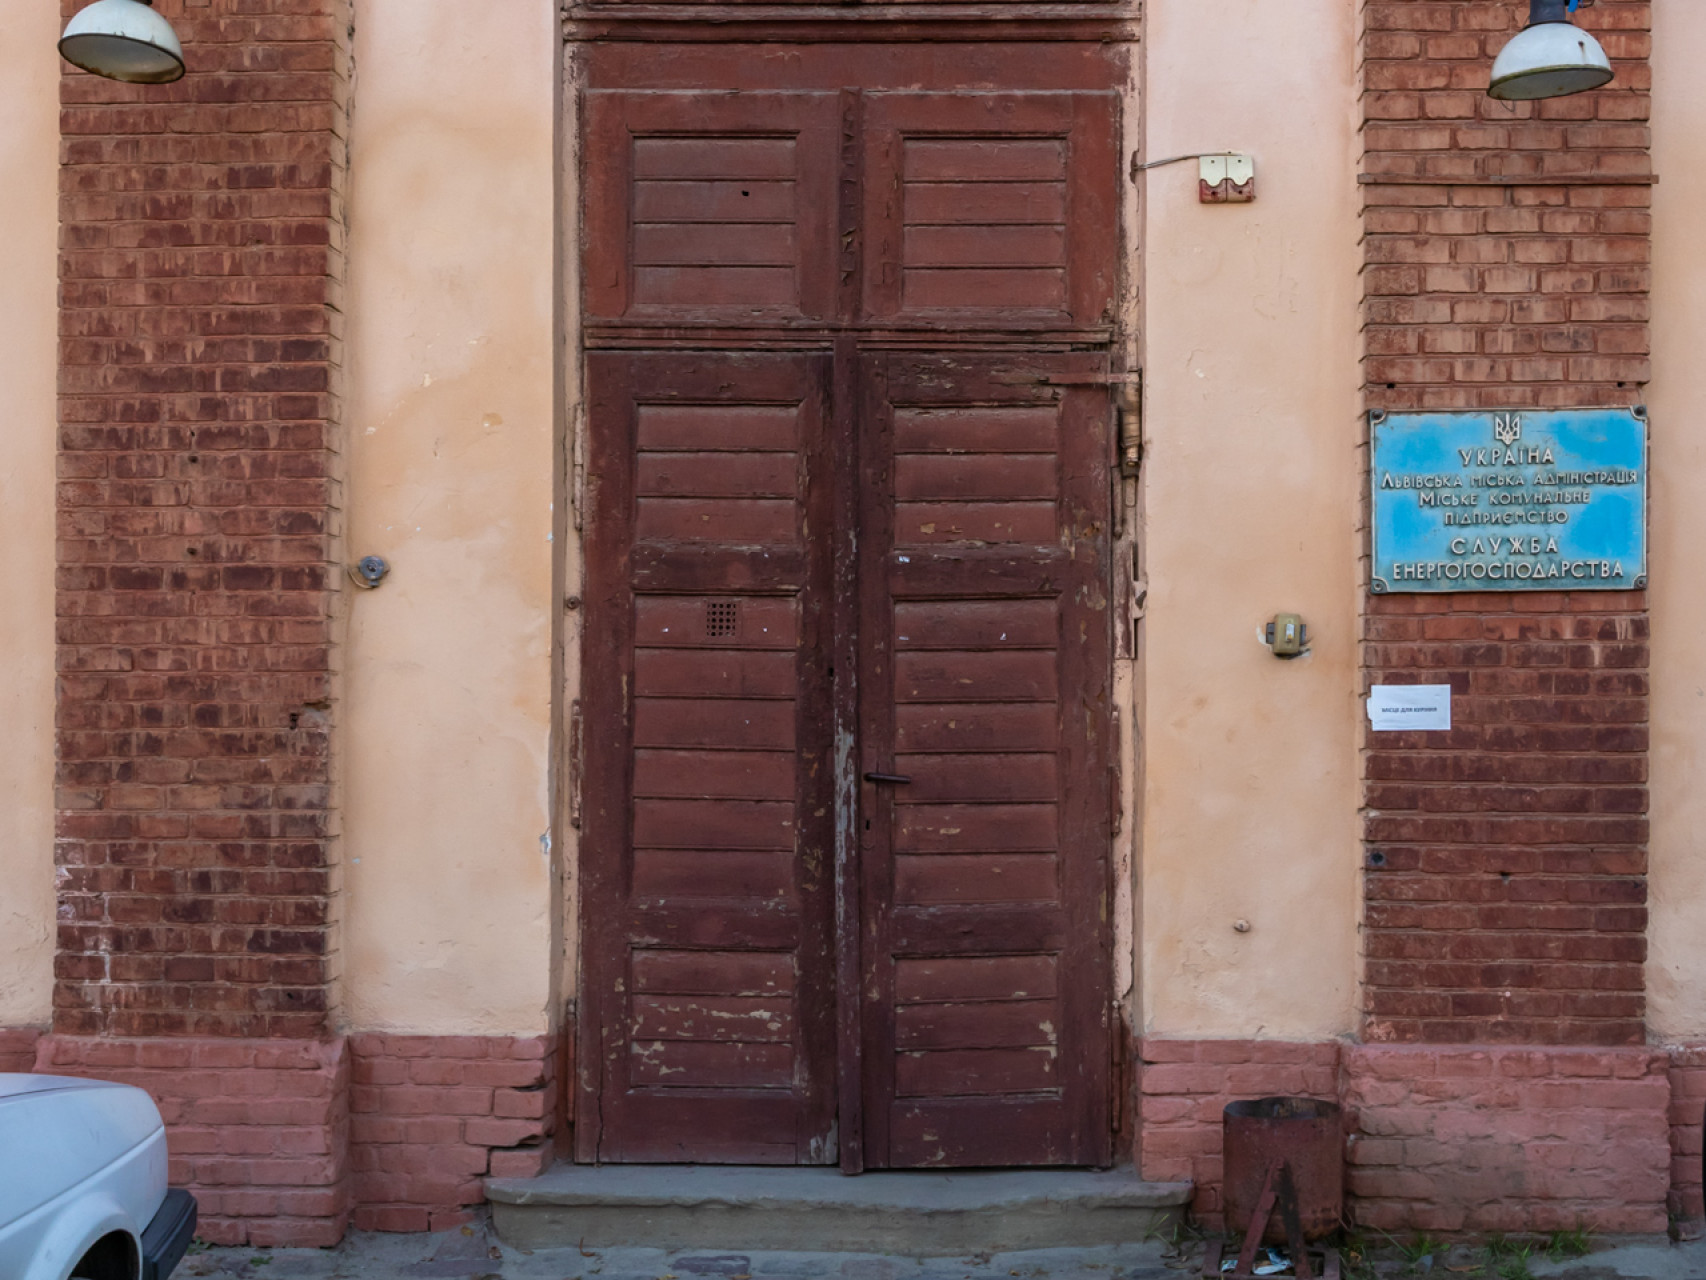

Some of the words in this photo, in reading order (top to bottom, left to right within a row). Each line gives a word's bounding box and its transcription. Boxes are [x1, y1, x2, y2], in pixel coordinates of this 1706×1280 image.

[1458, 447, 1555, 466] УКРАЇНА
[1381, 472, 1463, 489] ЛЬВІВСЬКА
[1470, 473, 1525, 487] МІСЬКА
[1534, 470, 1638, 485] АДМІНІСТРАЦІЯ
[1418, 491, 1478, 507] МІСЬКЕ
[1489, 490, 1591, 505] КОМУНАЛЬНЕ
[1444, 510, 1569, 526] ПІДПРИЄМСТВО
[1450, 536, 1559, 555] СЛУЖБА
[1393, 559, 1625, 580] ЕНЕРГОГОСПОДАРСТВА
